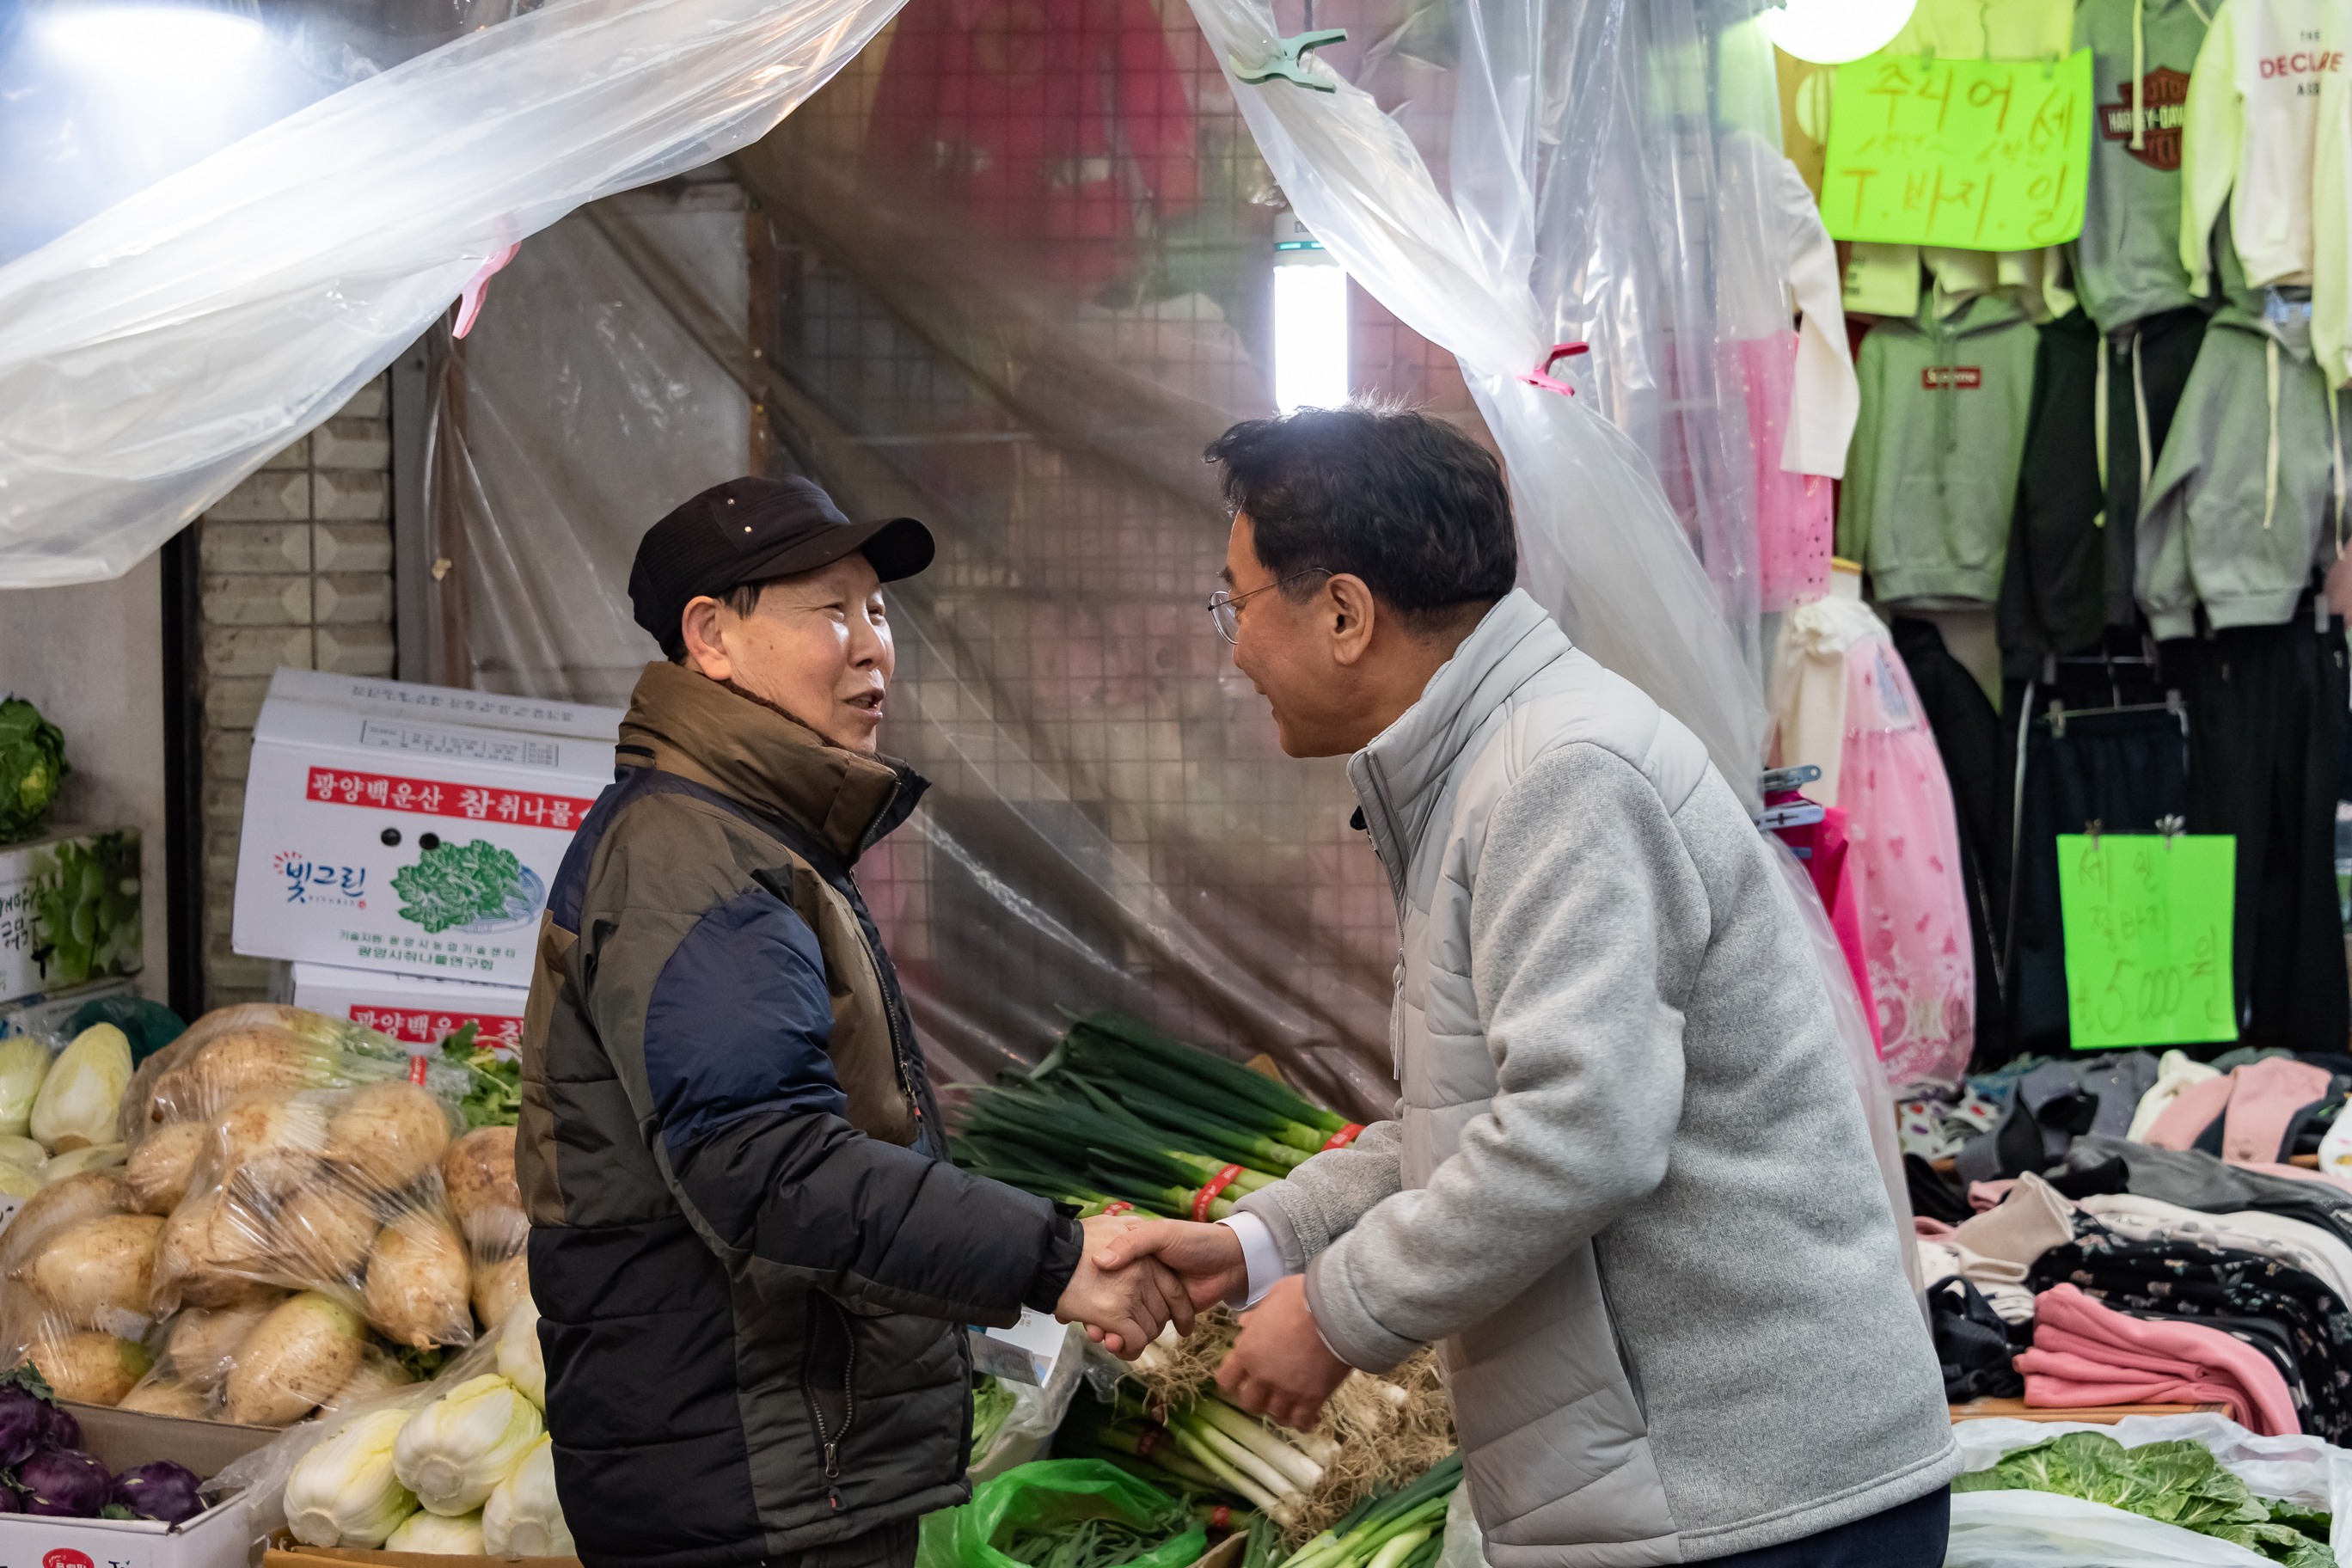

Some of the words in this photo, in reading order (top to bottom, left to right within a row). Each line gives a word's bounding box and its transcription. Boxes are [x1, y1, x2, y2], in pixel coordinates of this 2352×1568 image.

[310, 773, 444, 812] 광양백운산
[457, 788, 574, 828] 참취나물
[285, 861, 366, 904] 빛그린
